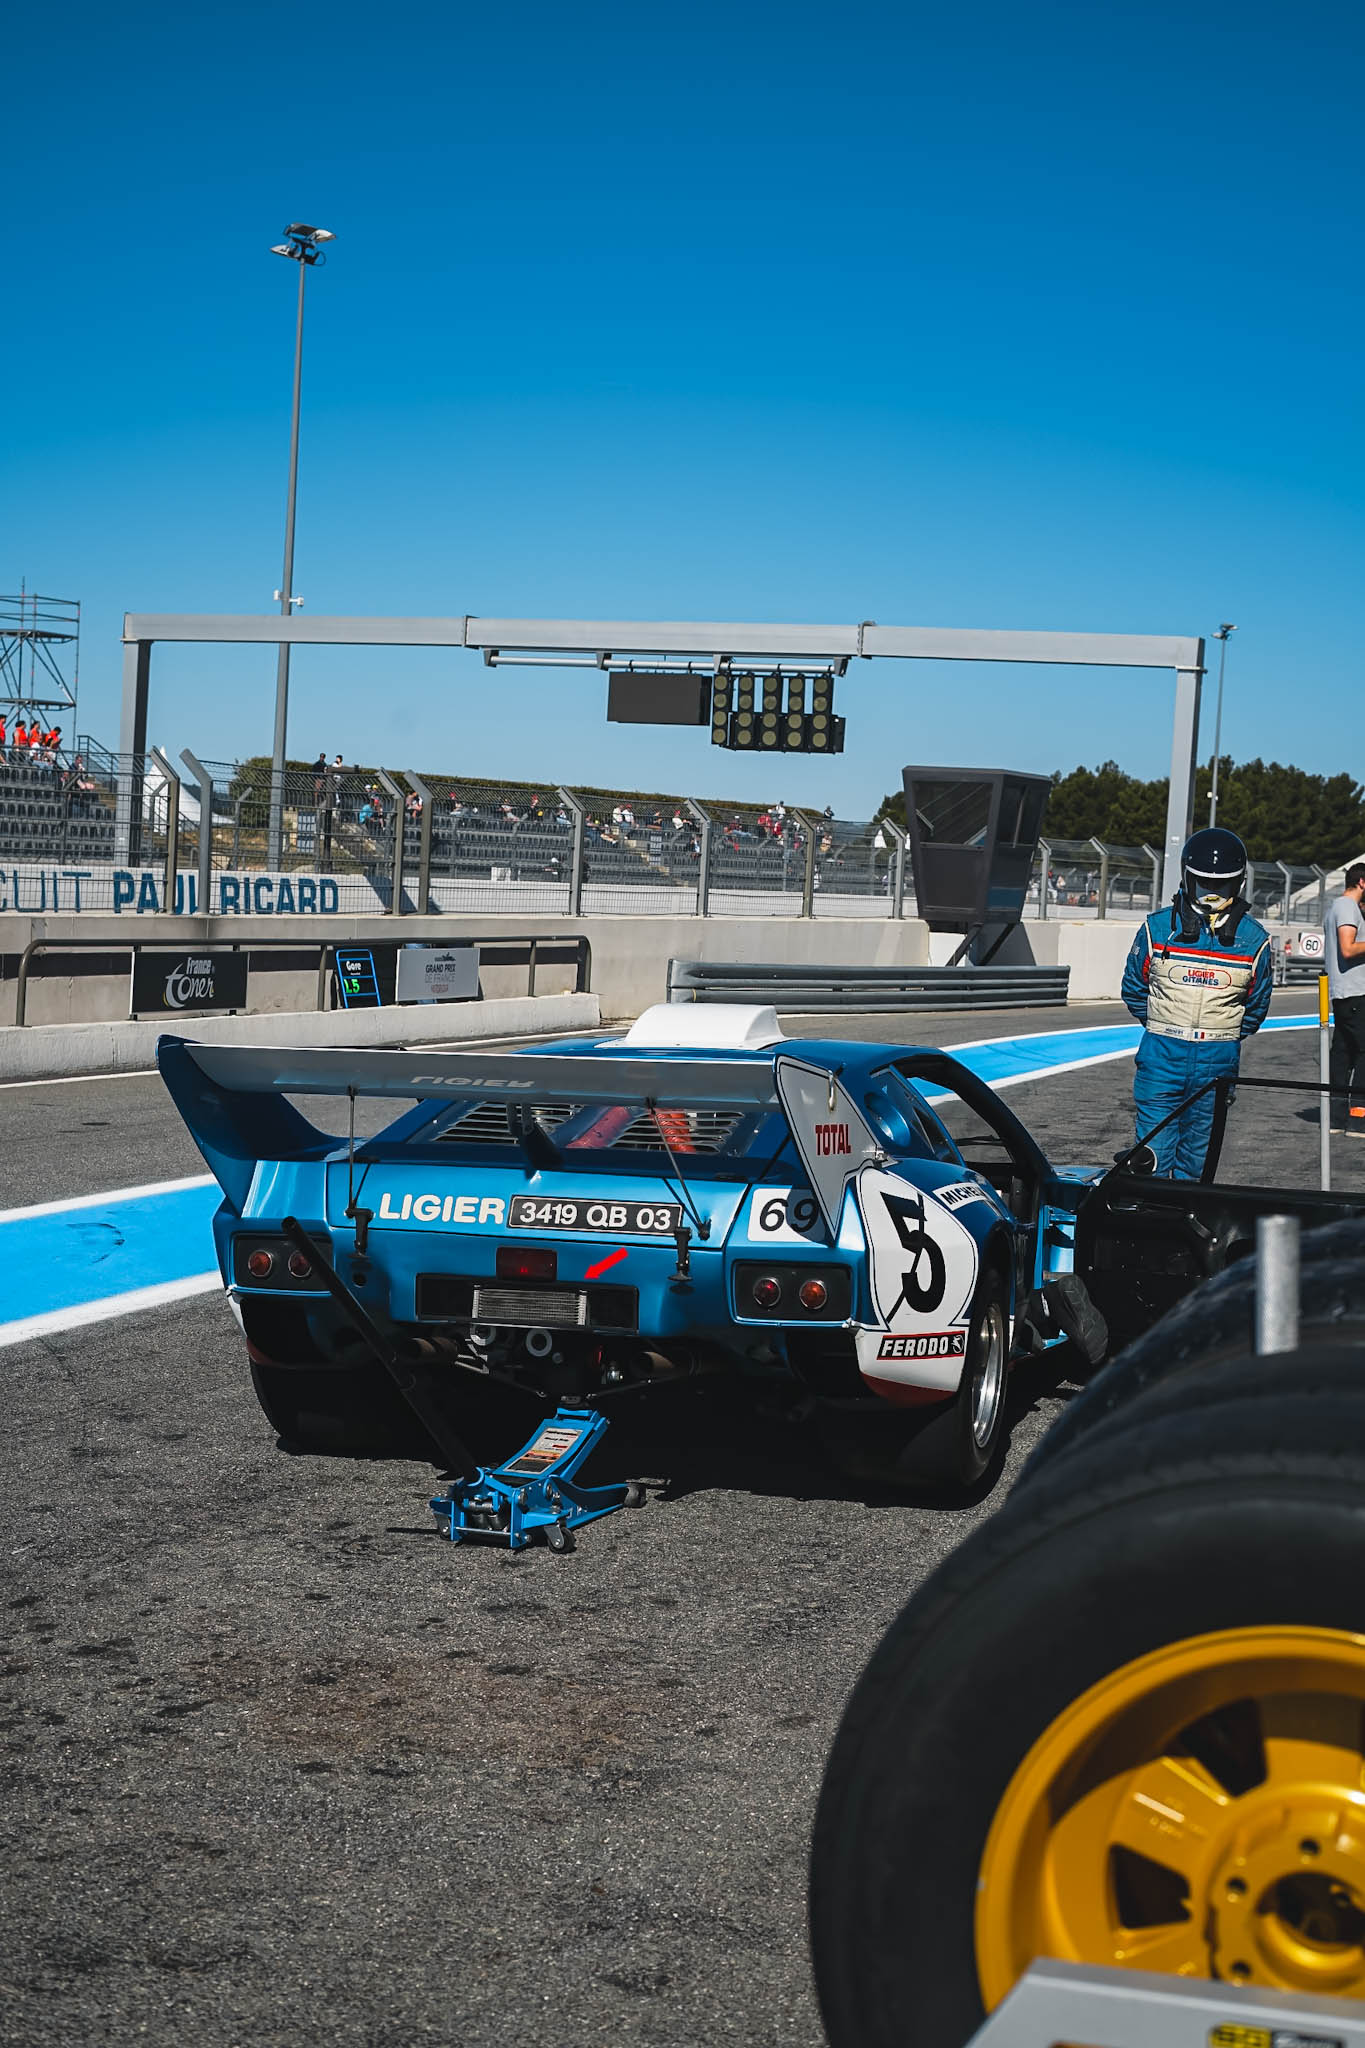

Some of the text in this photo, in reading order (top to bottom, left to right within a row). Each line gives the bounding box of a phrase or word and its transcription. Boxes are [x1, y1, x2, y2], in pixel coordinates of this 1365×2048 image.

[0, 870, 92, 913] UIT
[220, 876, 339, 915] RICARD
[1305, 939, 1319, 951] 60
[186, 957, 212, 975] France
[425, 963, 456, 973] GRAND PRIX
[1187, 969, 1215, 979] LIGIER
[815, 1123, 852, 1156] TOTAL
[379, 1193, 506, 1225] LIGIER
[519, 1202, 672, 1230] 3419 QB 03
[759, 1198, 820, 1233] 69
[879, 1191, 947, 1313] 5
[881, 1335, 950, 1357] FERODO
